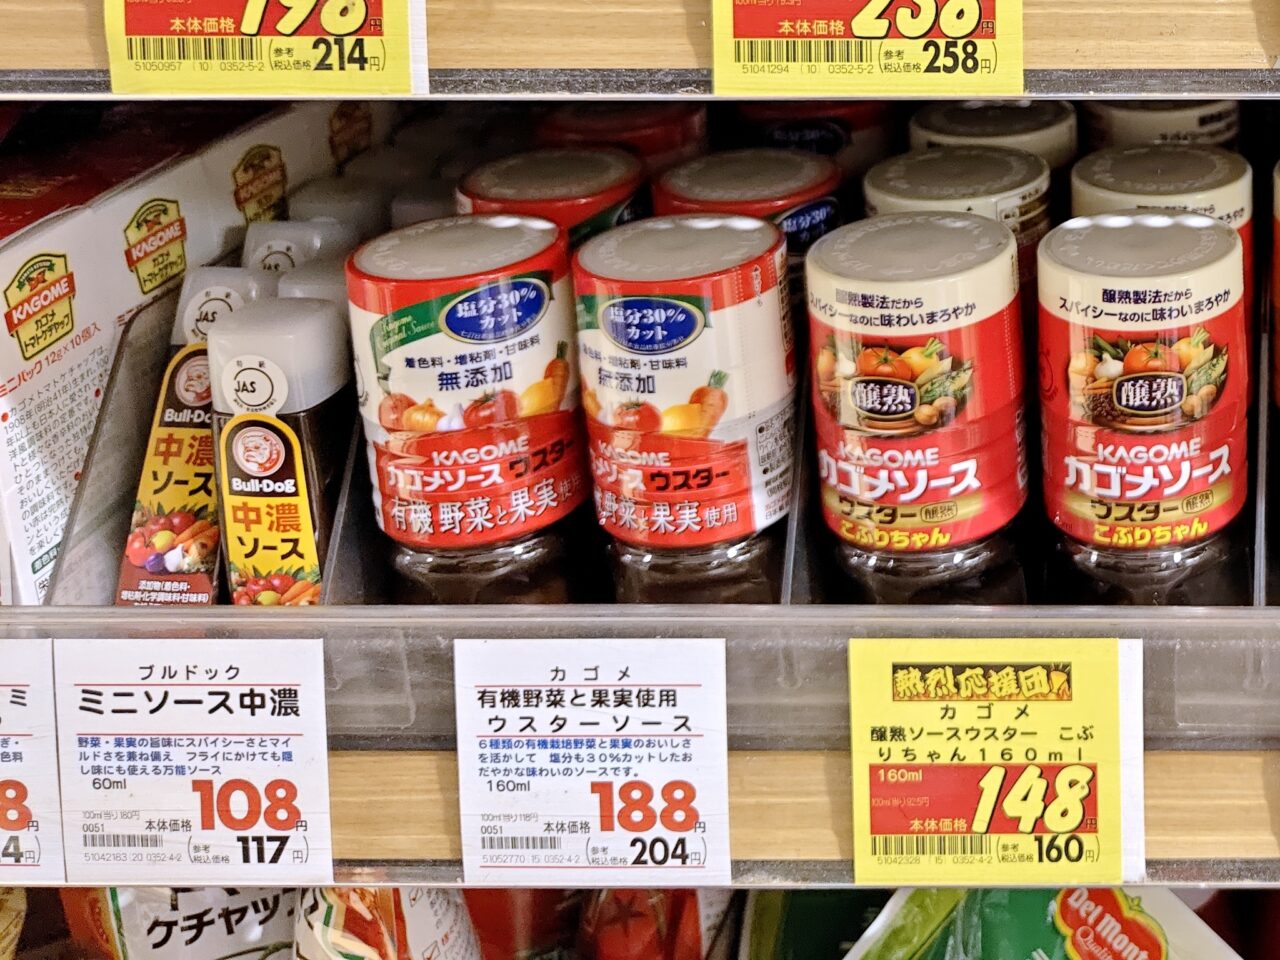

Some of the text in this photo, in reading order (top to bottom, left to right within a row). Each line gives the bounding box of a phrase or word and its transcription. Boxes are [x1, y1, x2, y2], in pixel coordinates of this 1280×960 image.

[171, 17, 236, 34] 本体価格
[778, 20, 845, 35] 本体価格
[11, 277, 70, 324] KAGOME
[437, 360, 514, 393] 無添加
[432, 437, 529, 465] KAGOME
[1097, 437, 1202, 464] KAGOME
[1064, 443, 1232, 500] カゴメソース
[230, 502, 303, 533] 中濃
[236, 536, 305, 561] ソース
[138, 665, 241, 681] ブルドック
[550, 666, 631, 682] カゴメ
[79, 687, 300, 717] ミニソース中濃
[477, 689, 677, 709] 有機野菜と果実使用
[940, 704, 1030, 720] カゴメ
[488, 715, 692, 733] ウスターソース
[878, 769, 922, 782] 160ml
[92, 779, 126, 790] 60ml
[487, 780, 530, 792] 160ml
[145, 820, 192, 832] 本体価格
[543, 821, 591, 834] 本体価格
[910, 819, 967, 832] 本体価格
